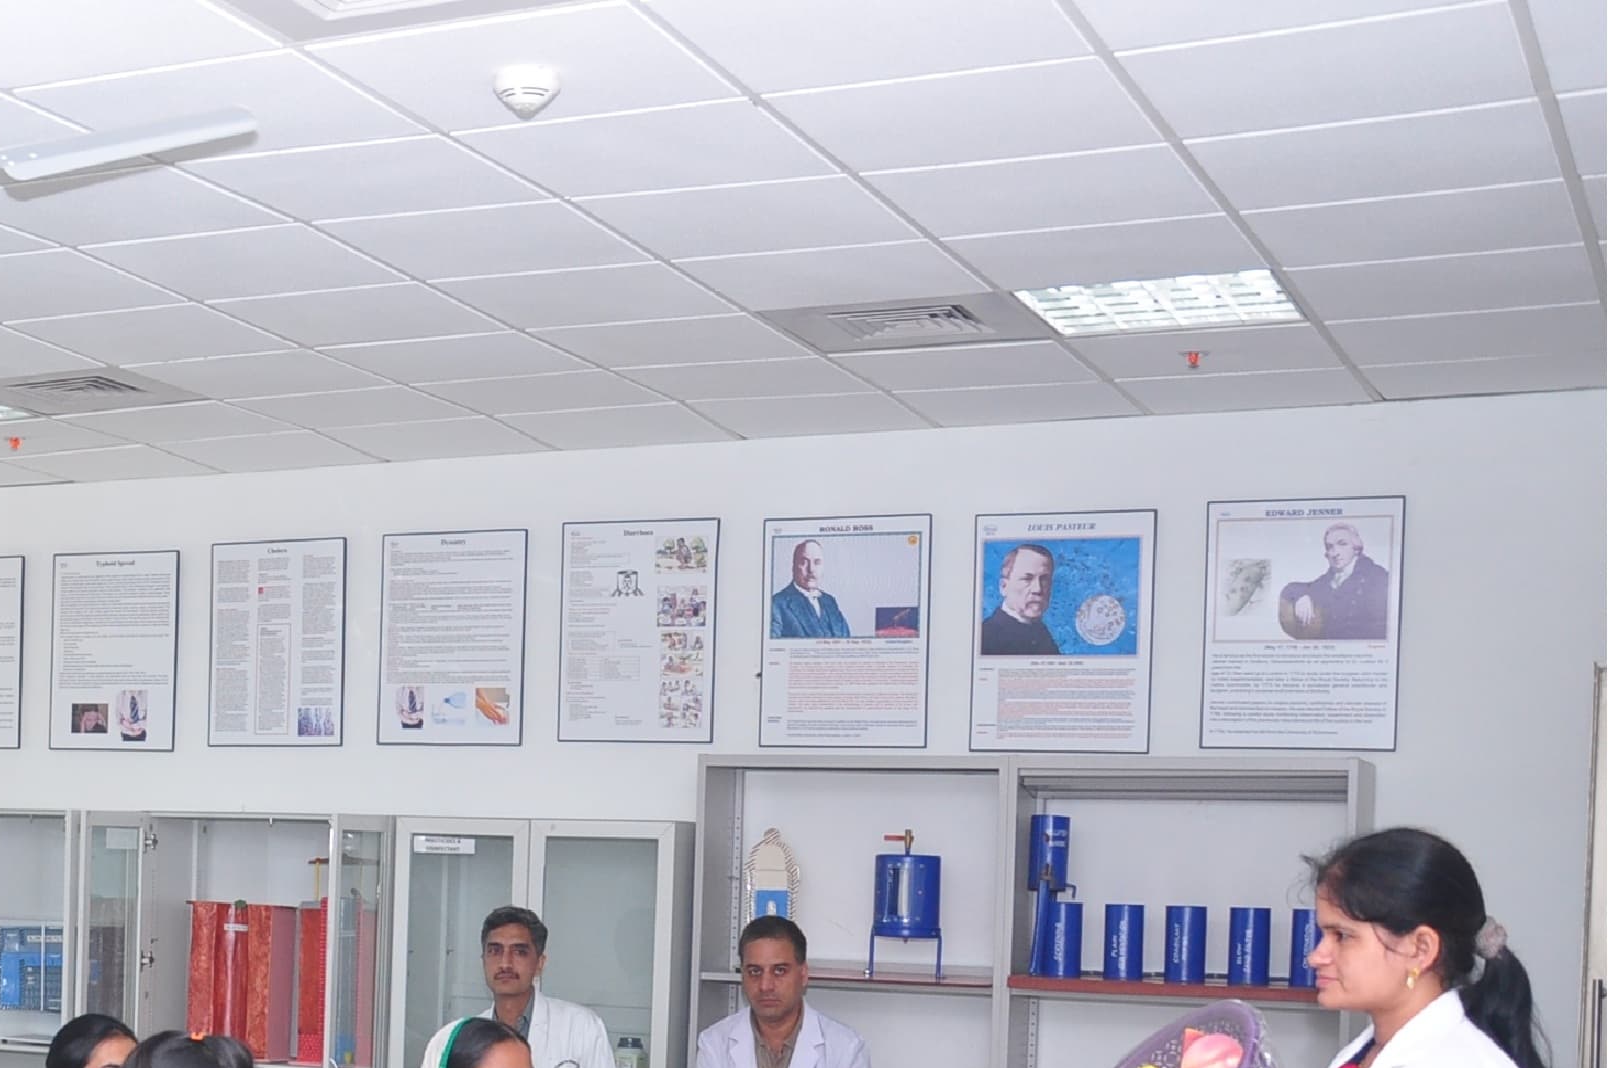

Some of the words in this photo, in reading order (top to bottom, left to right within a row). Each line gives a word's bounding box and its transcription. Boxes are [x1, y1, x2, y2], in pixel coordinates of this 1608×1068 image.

[1265, 509, 1305, 517] EDWARD
[1306, 508, 1343, 516] JENNER
[818, 525, 851, 533] RONALD
[852, 524, 874, 532] ROSS
[1027, 524, 1052, 532] LOUIS
[1053, 522, 1097, 531] PASTEUR
